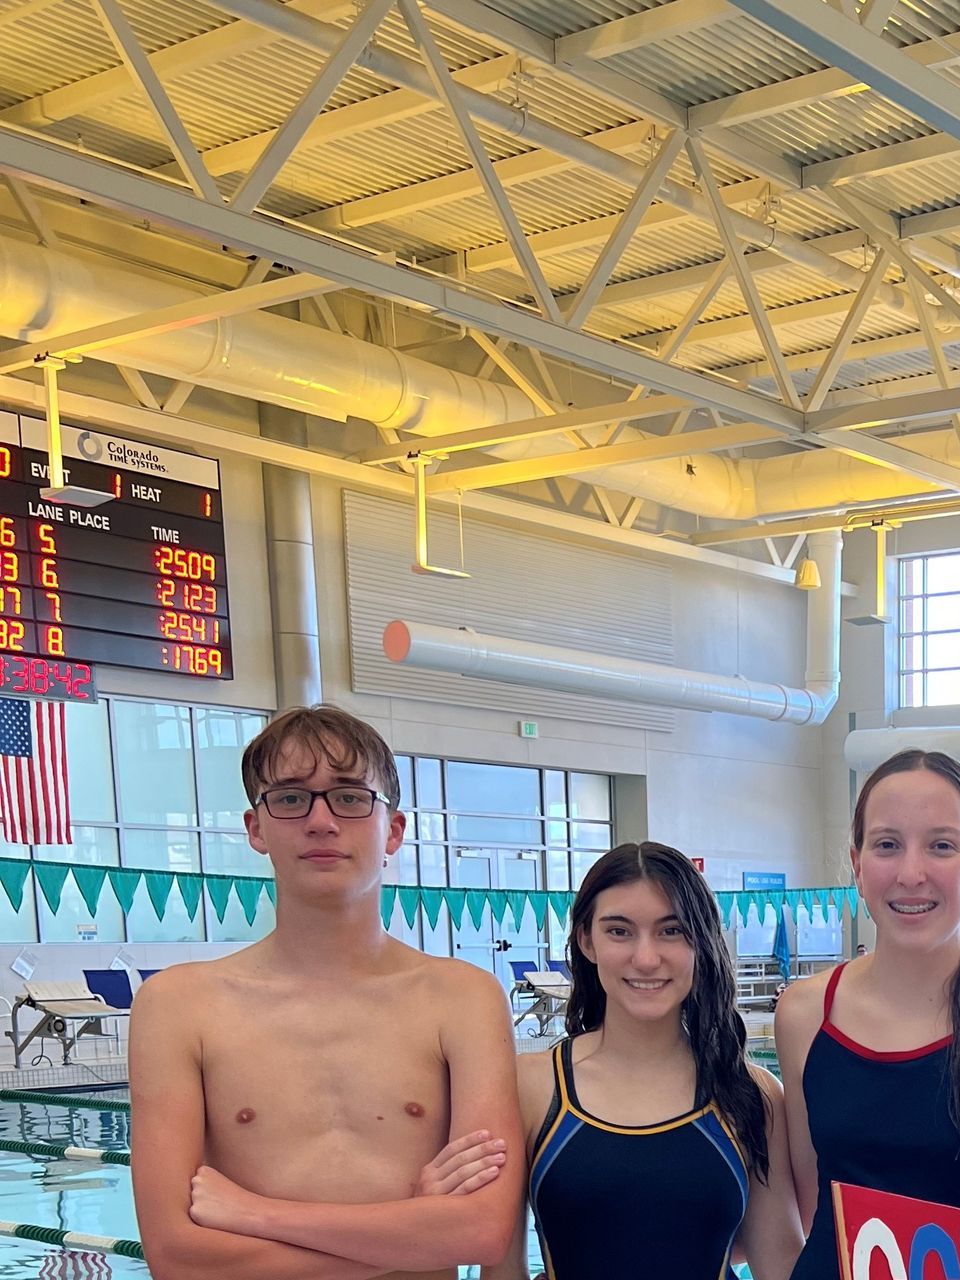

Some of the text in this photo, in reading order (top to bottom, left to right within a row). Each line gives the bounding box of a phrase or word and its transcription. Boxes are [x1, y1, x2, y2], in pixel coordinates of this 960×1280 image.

[107, 441, 159, 463] Colorado
[109, 453, 128, 465] TIME
[31, 462, 71, 483] EVT
[131, 483, 162, 503] HEAT
[28, 501, 111, 531] LANE PLACE
[151, 525, 180, 544] TIME
